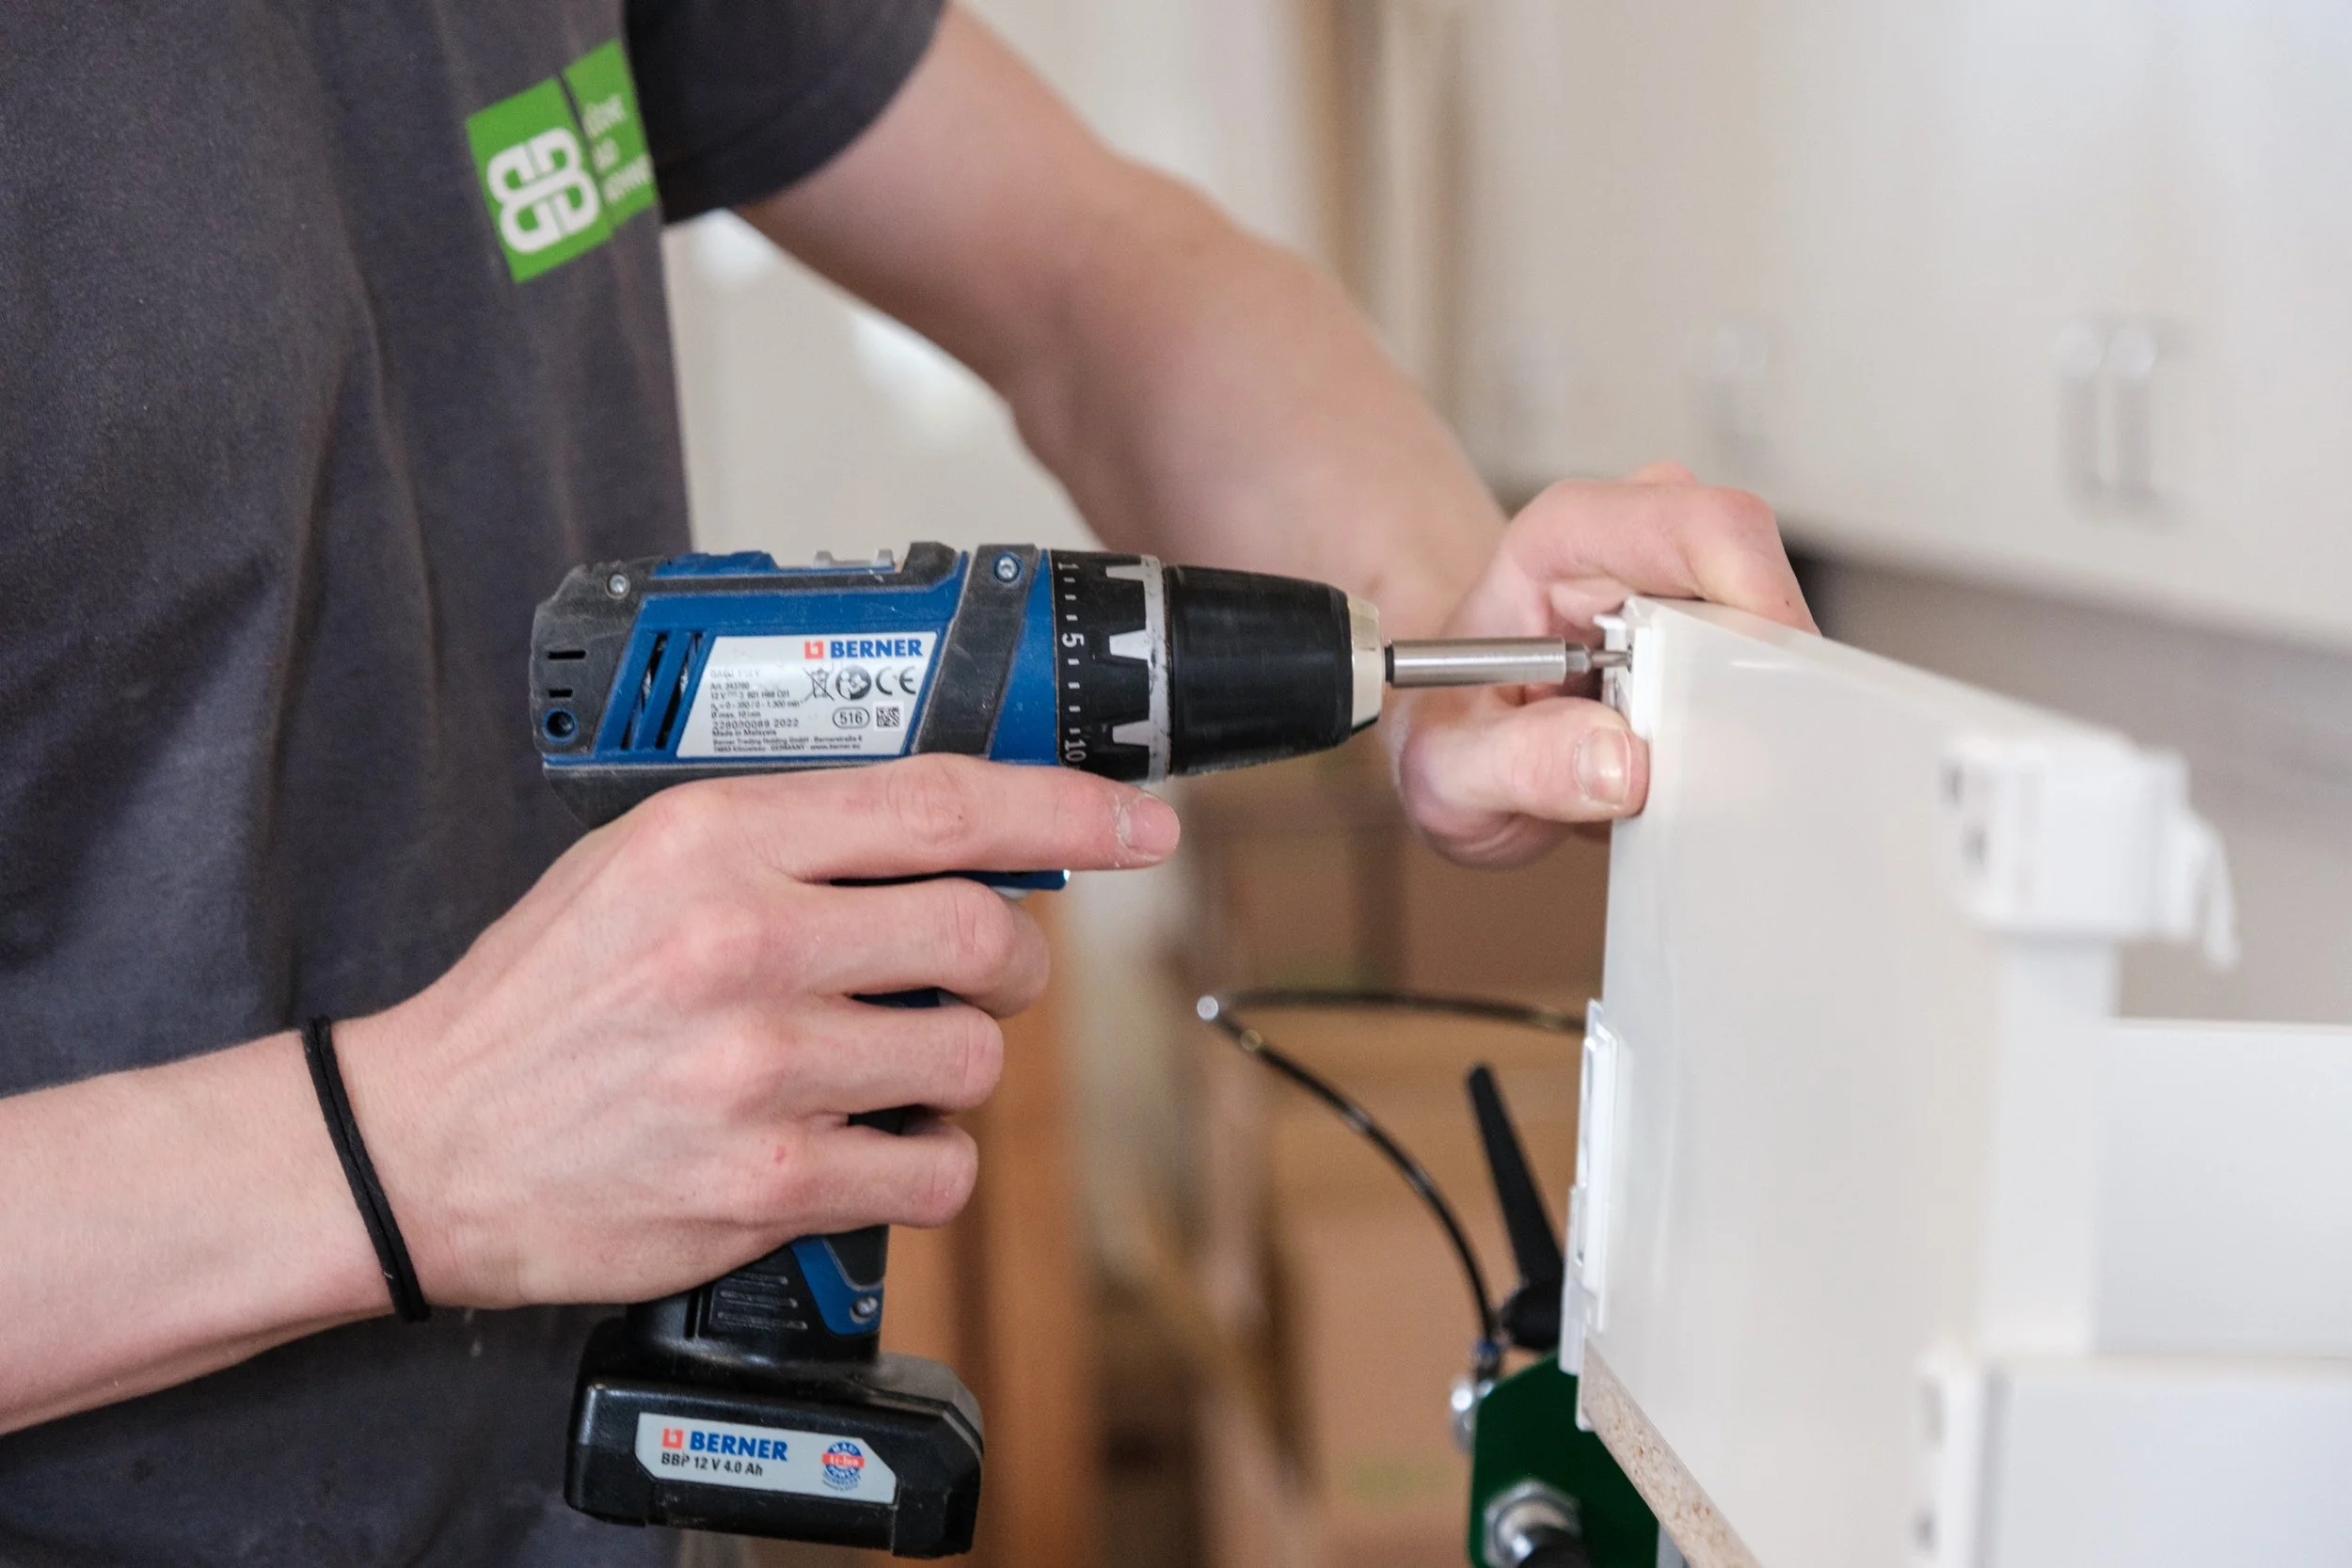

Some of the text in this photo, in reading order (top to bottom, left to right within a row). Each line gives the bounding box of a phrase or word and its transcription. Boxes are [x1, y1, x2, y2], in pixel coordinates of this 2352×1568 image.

[1062, 632, 1085, 648] 5
[830, 640, 923, 657] BERNER
[774, 718, 799, 728] 2022
[839, 711, 863, 724] 516
[712, 728, 733, 736] Made
[743, 729, 776, 737] Malaysia
[1065, 740, 1087, 762] 10
[690, 1430, 787, 1462] BERNER
[661, 1451, 763, 1477] BBP 12 V 4.0 Ah
